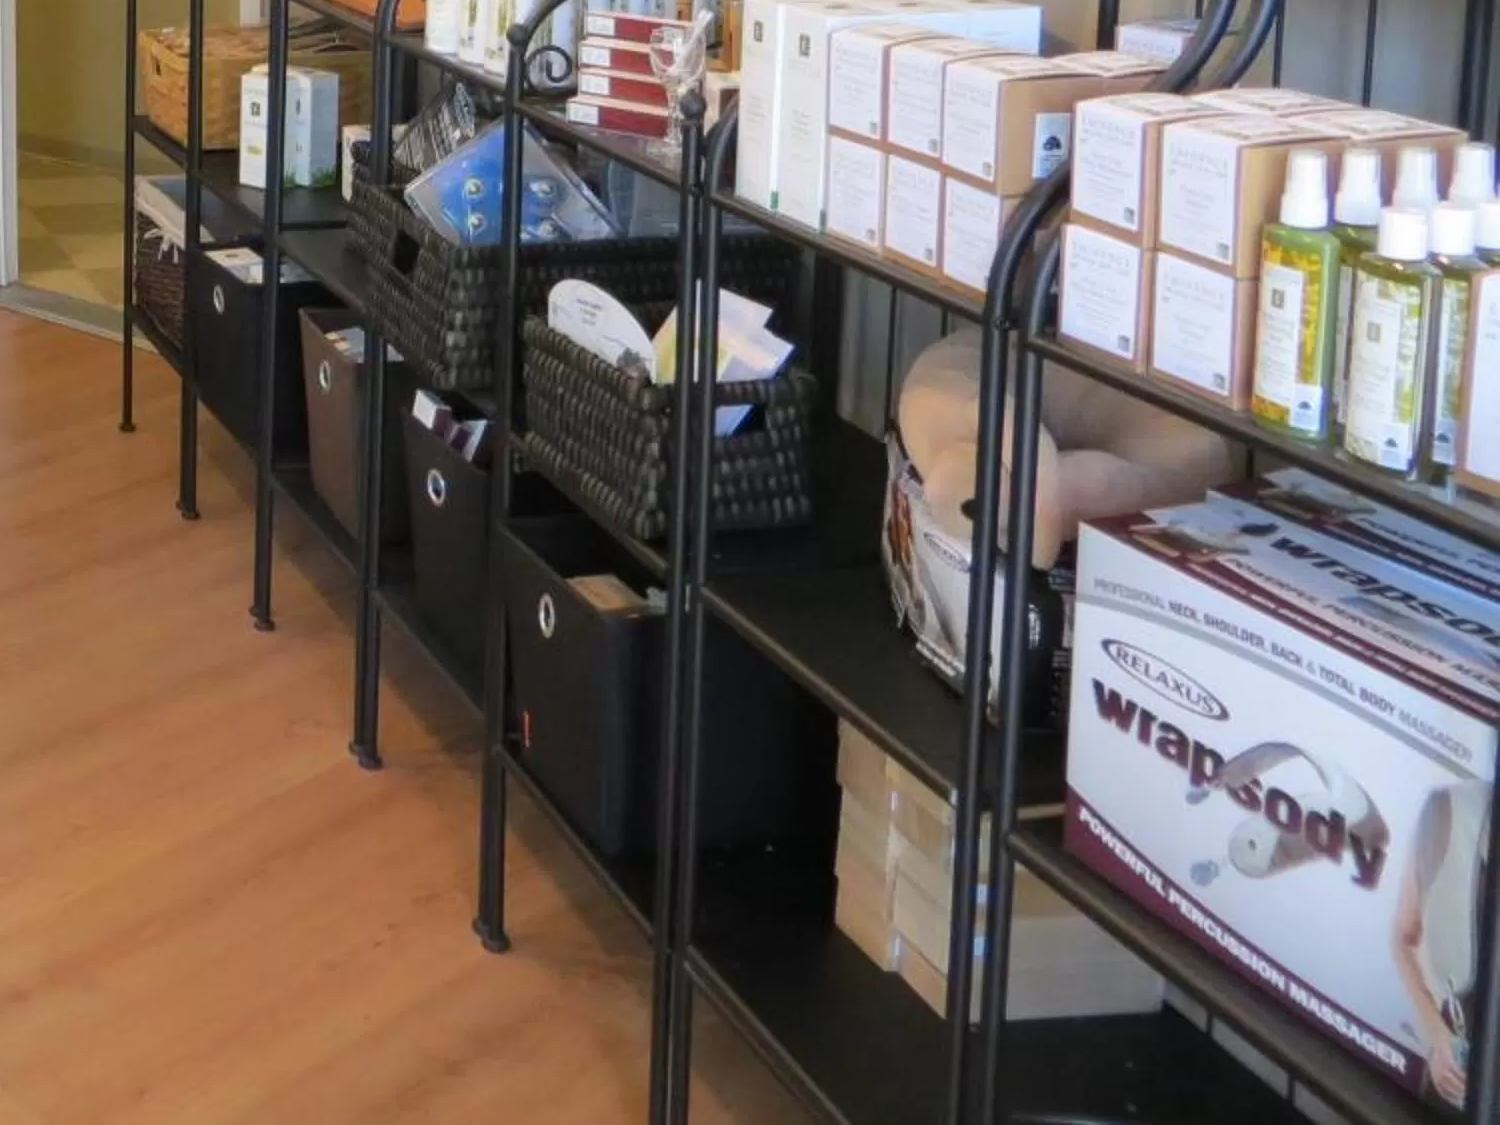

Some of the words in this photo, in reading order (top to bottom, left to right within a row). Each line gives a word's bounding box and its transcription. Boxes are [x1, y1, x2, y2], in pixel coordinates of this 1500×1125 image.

[1114, 645, 1217, 714] RELAXUS
[1271, 642, 1303, 668] BACK
[1319, 663, 1357, 696] TOTAL
[1358, 686, 1397, 717] BODY
[1398, 708, 1474, 764] MASSAGER
[1091, 677, 1388, 892] wrapsody
[1079, 805, 1168, 898] POWERFUL
[1167, 886, 1287, 992] PERCUSSION
[1288, 979, 1407, 1075] MASSAGER
